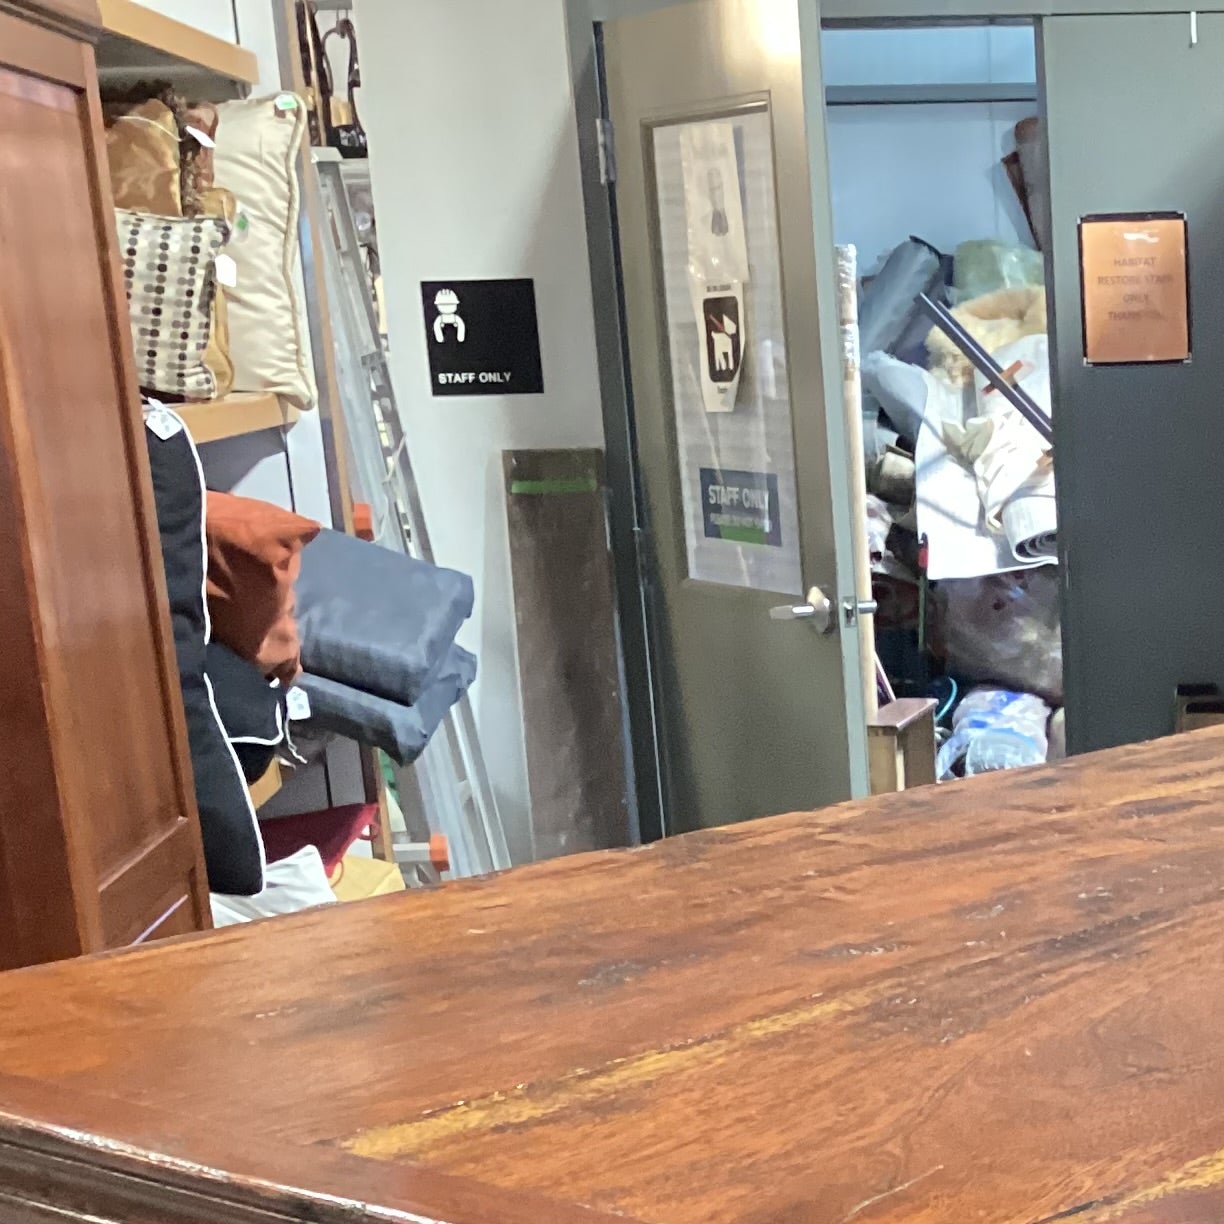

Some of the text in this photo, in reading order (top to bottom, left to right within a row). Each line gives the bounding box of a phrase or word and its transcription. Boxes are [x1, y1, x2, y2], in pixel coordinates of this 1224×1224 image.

[1114, 257, 1156, 266] HABITAT
[438, 372, 511, 384] STAFF ONLY
[708, 484, 739, 507] STAFF
